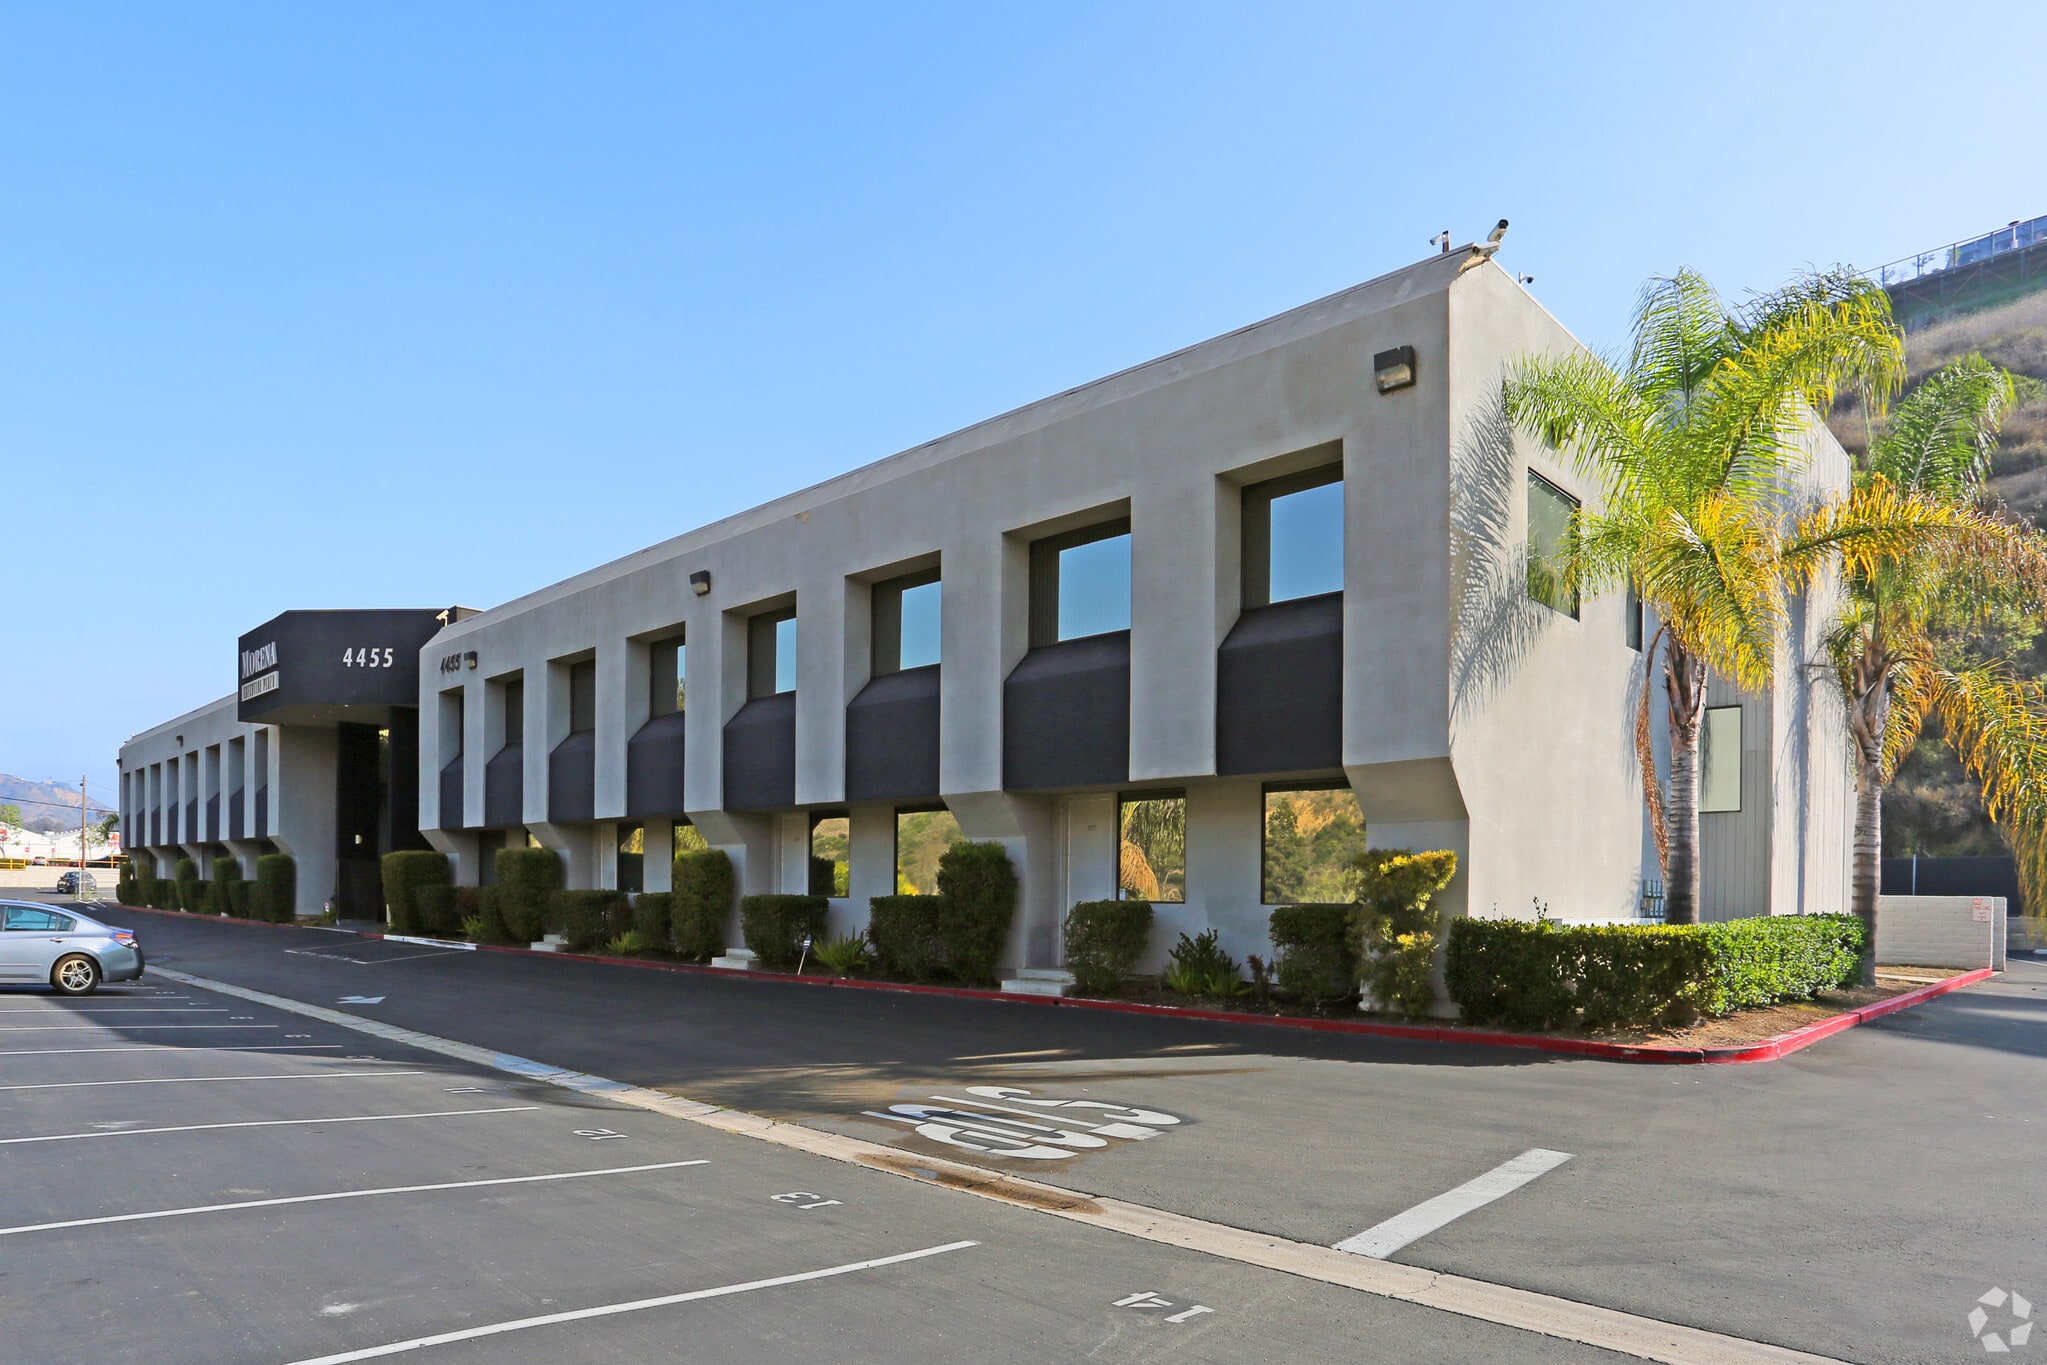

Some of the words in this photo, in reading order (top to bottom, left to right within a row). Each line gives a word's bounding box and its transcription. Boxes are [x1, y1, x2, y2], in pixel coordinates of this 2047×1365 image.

[241, 641, 277, 679] MORENA
[342, 647, 394, 668] 4455
[440, 652, 462, 675] 4455
[861, 1085, 1181, 1160] STOP
[573, 1128, 629, 1141] 12
[770, 1191, 844, 1211] 13
[1112, 1291, 1215, 1323] 14
